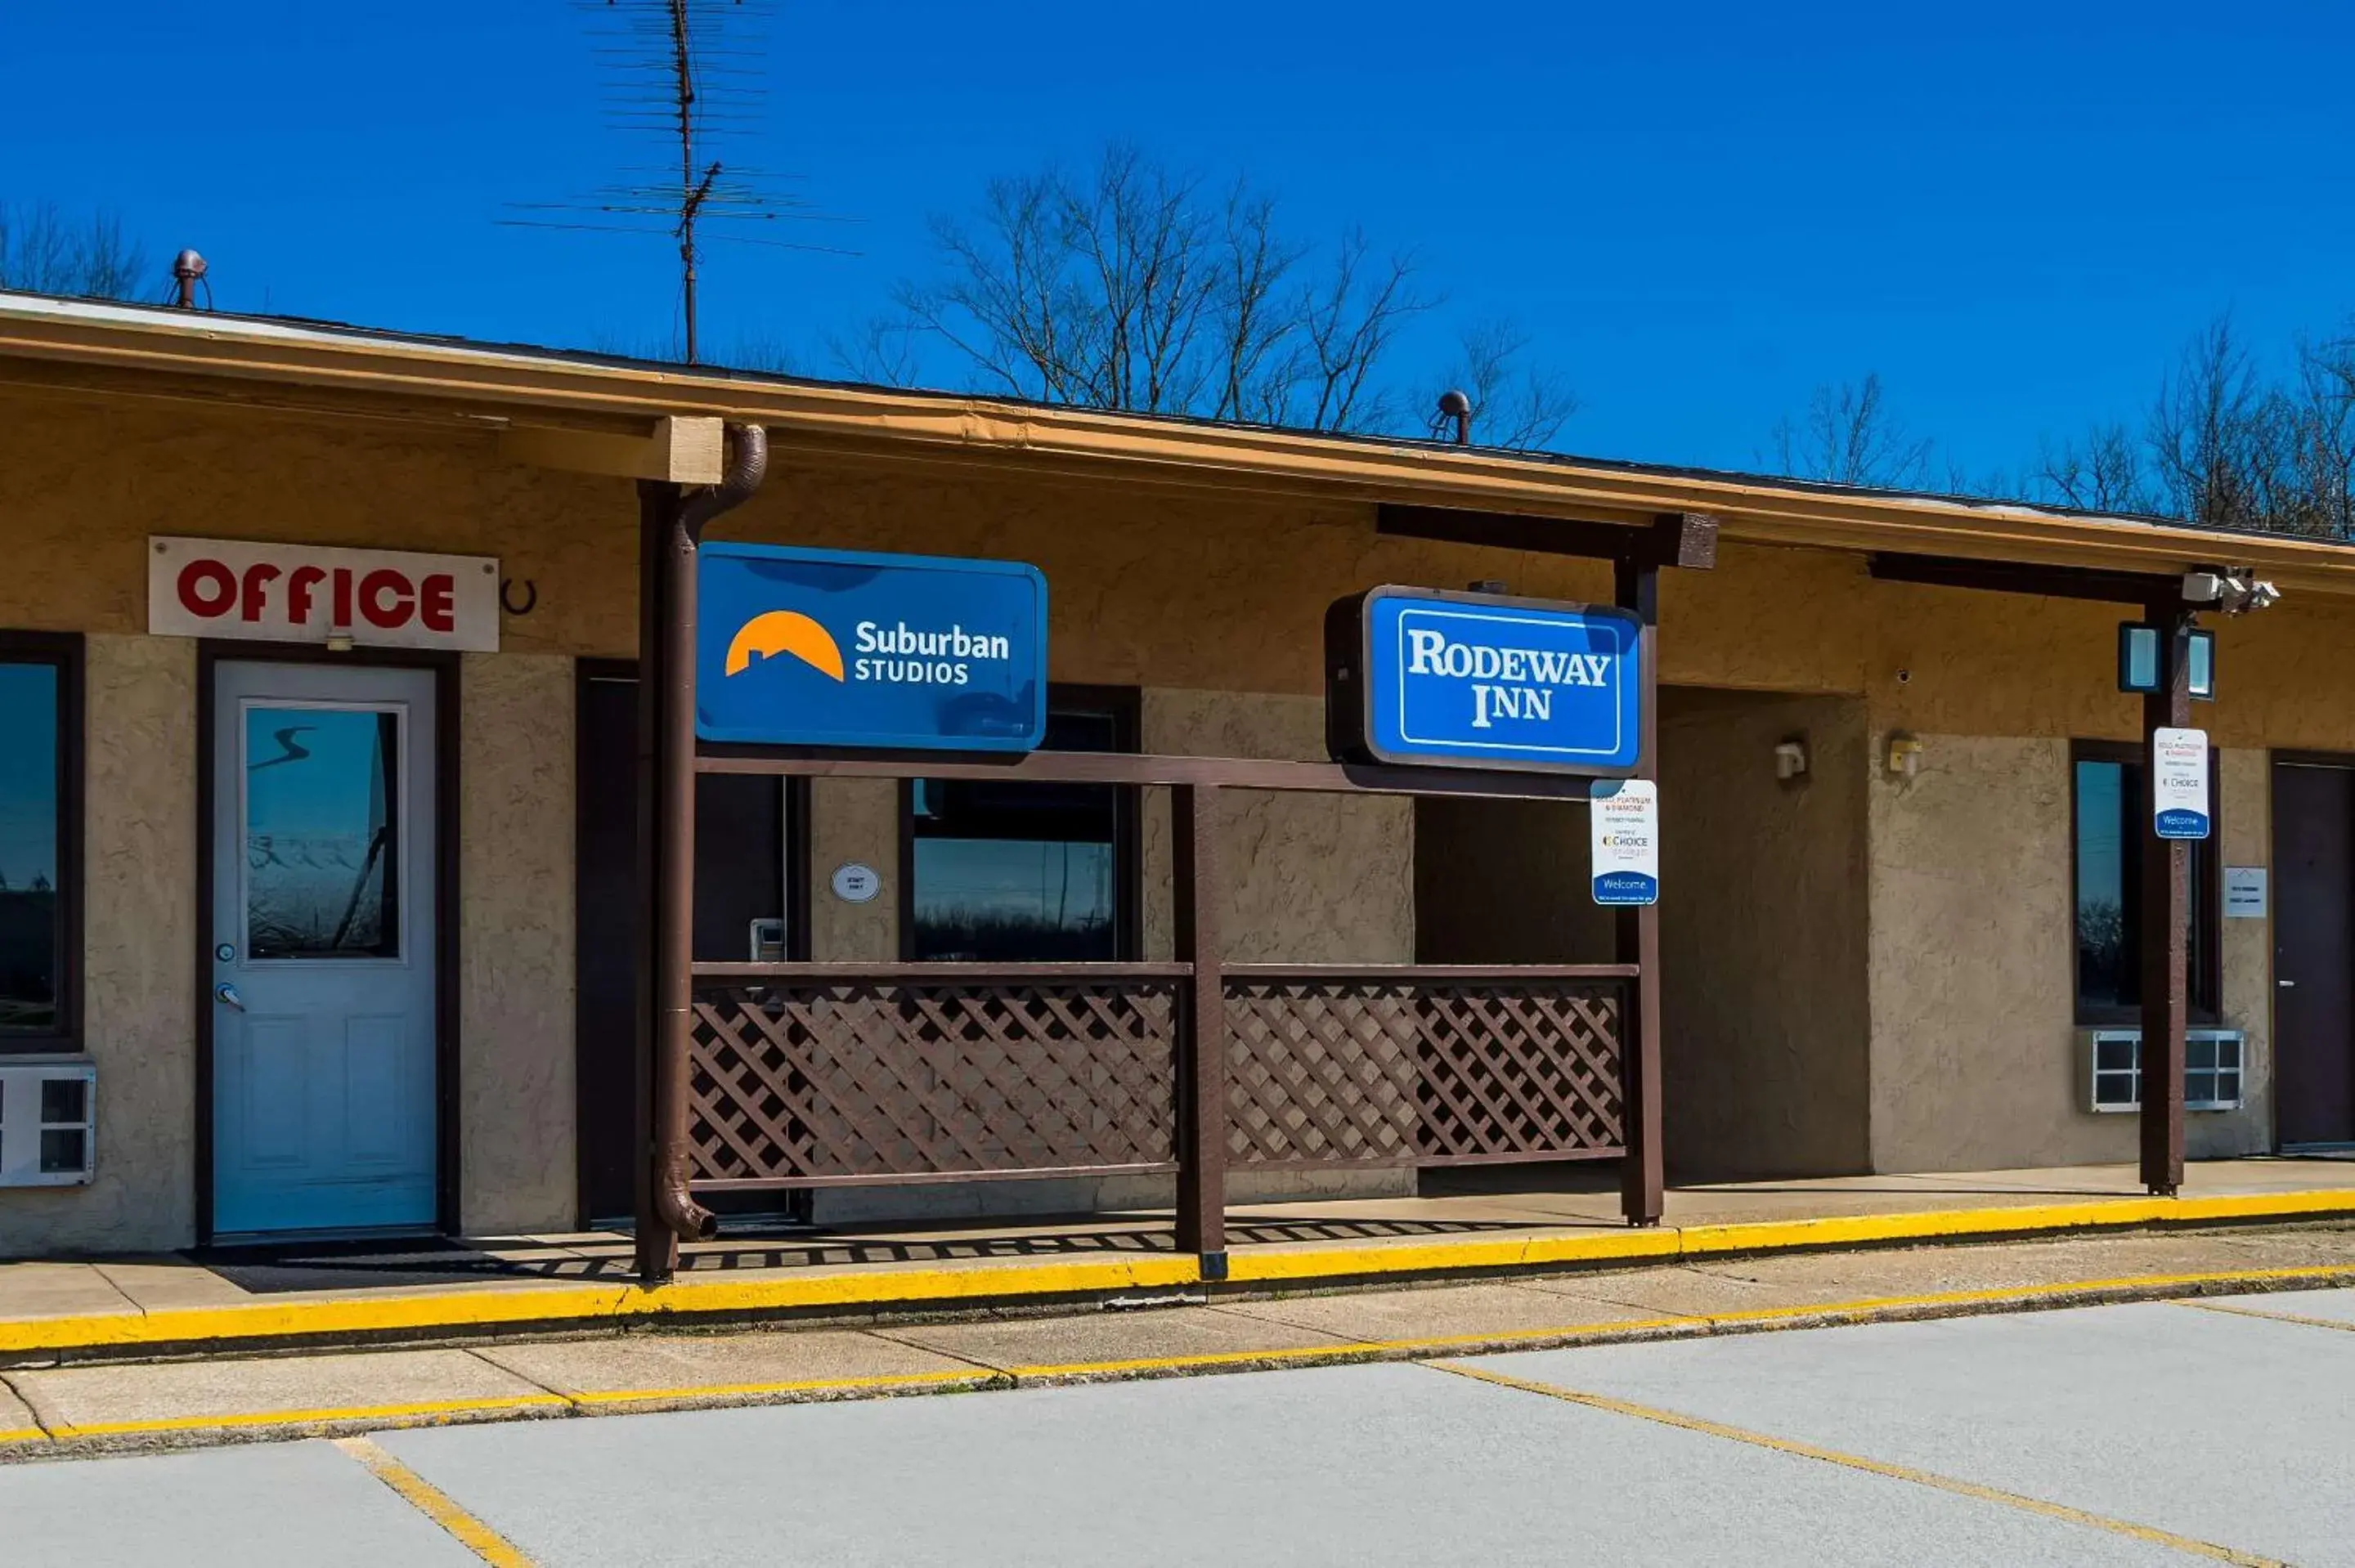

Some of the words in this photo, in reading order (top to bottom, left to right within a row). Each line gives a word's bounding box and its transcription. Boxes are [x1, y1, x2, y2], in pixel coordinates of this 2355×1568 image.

[177, 559, 455, 633] OFFICE
[855, 620, 1009, 660] Suburban
[1407, 629, 1612, 687] RODEWAY
[855, 658, 969, 685] STUDIOS
[1471, 683, 1553, 728] INN
[1613, 836, 1648, 847] CHOICE
